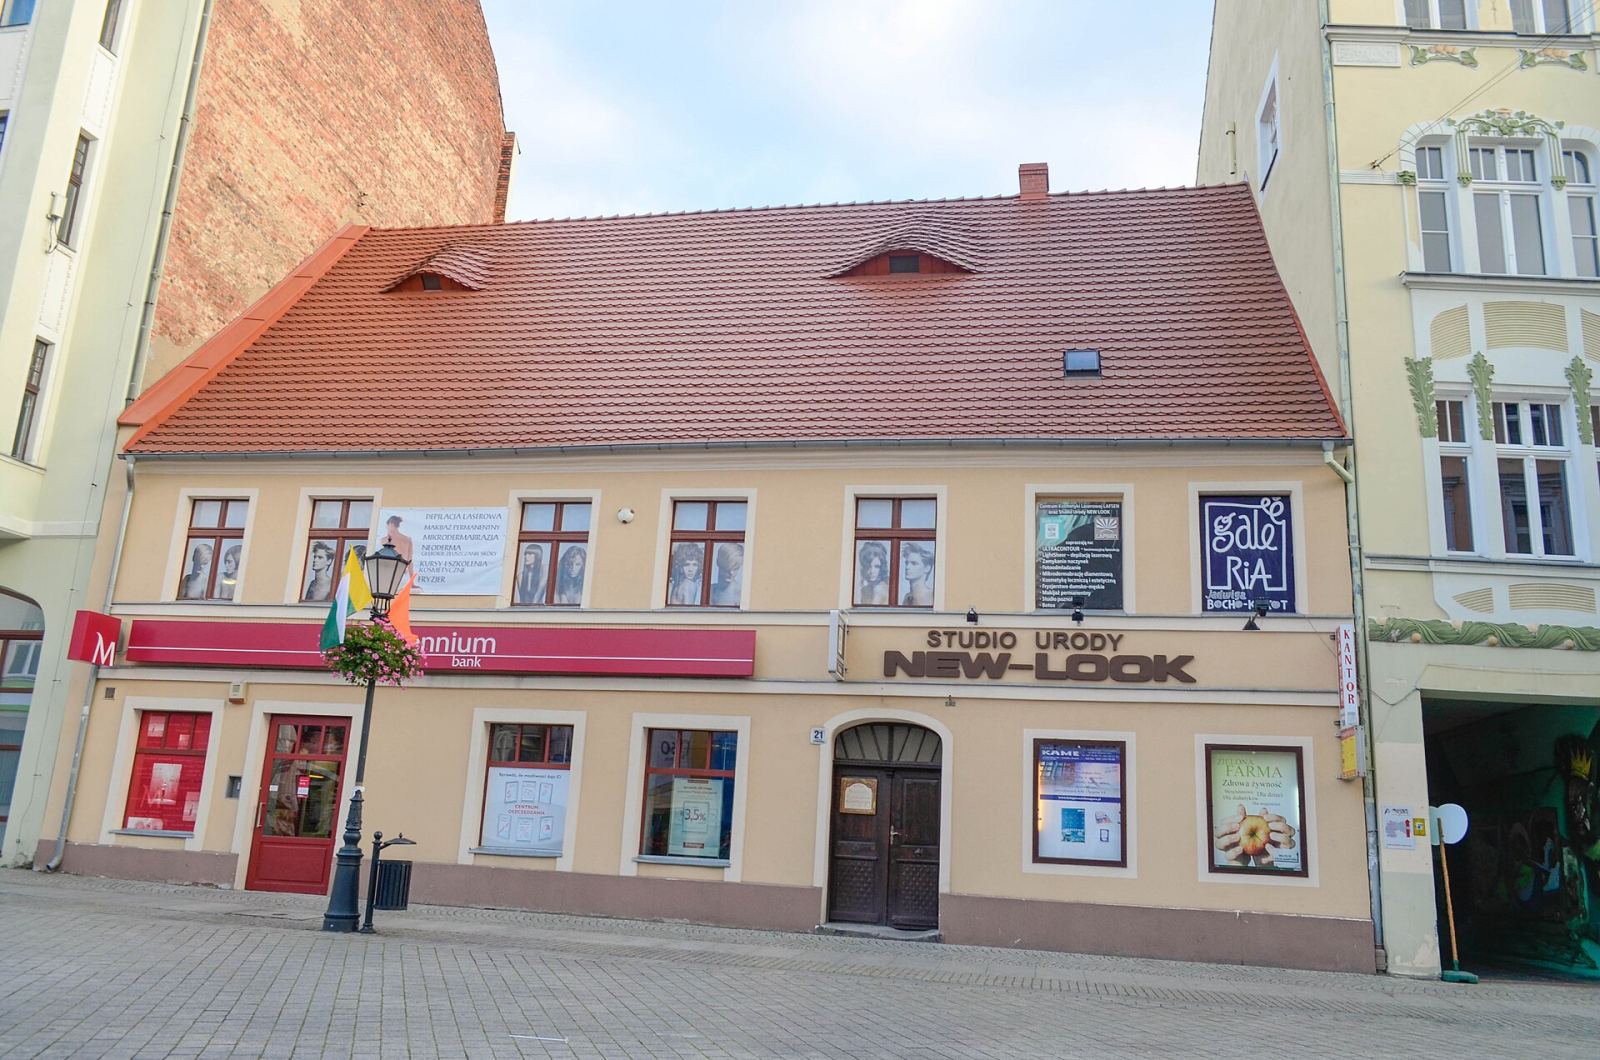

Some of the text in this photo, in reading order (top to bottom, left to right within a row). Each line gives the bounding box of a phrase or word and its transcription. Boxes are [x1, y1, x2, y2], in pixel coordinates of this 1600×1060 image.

[927, 630, 1124, 651] STUDIO URODY
[92, 632, 115, 666] M
[452, 656, 481, 667] bank
[884, 650, 1197, 683] NEW-LOOK
[1344, 630, 1355, 704] KANTOR
[814, 730, 823, 739] 21
[1226, 766, 1283, 777] FARMA
[1252, 780, 1282, 788] żywność
[685, 809, 706, 821] 3,5%
